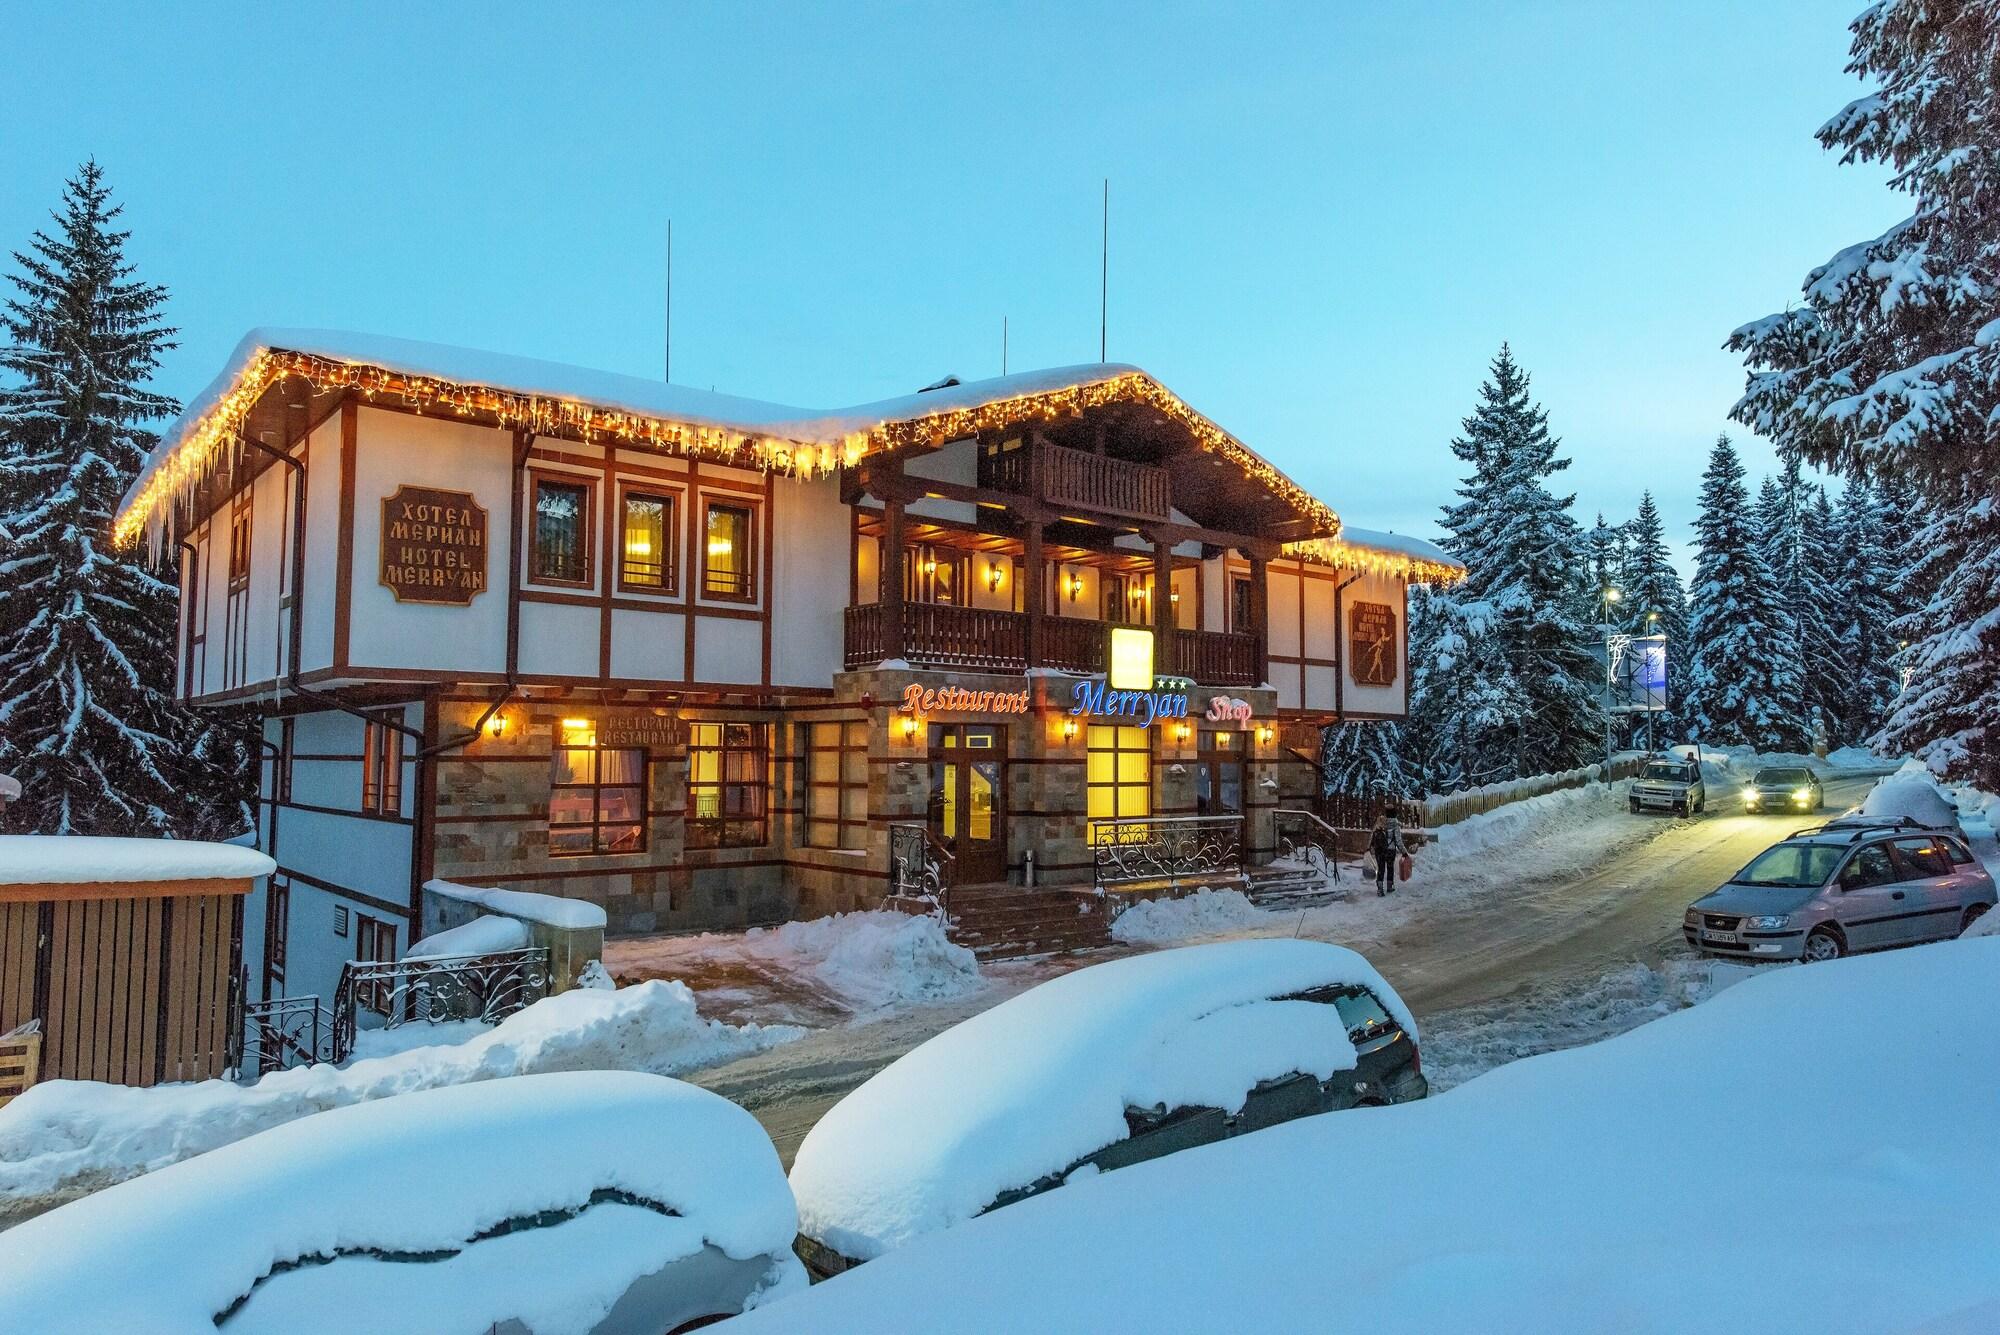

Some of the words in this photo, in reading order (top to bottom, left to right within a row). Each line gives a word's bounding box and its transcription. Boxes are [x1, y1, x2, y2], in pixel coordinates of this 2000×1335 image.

[402, 502, 471, 526] ХОТЕЛ
[401, 547, 471, 568] HOTEL
[385, 565, 483, 588] MERRYAN
[899, 683, 1030, 718] Restaurant
[1071, 680, 1188, 728] Merryan
[604, 730, 682, 744] RESTAURANT
